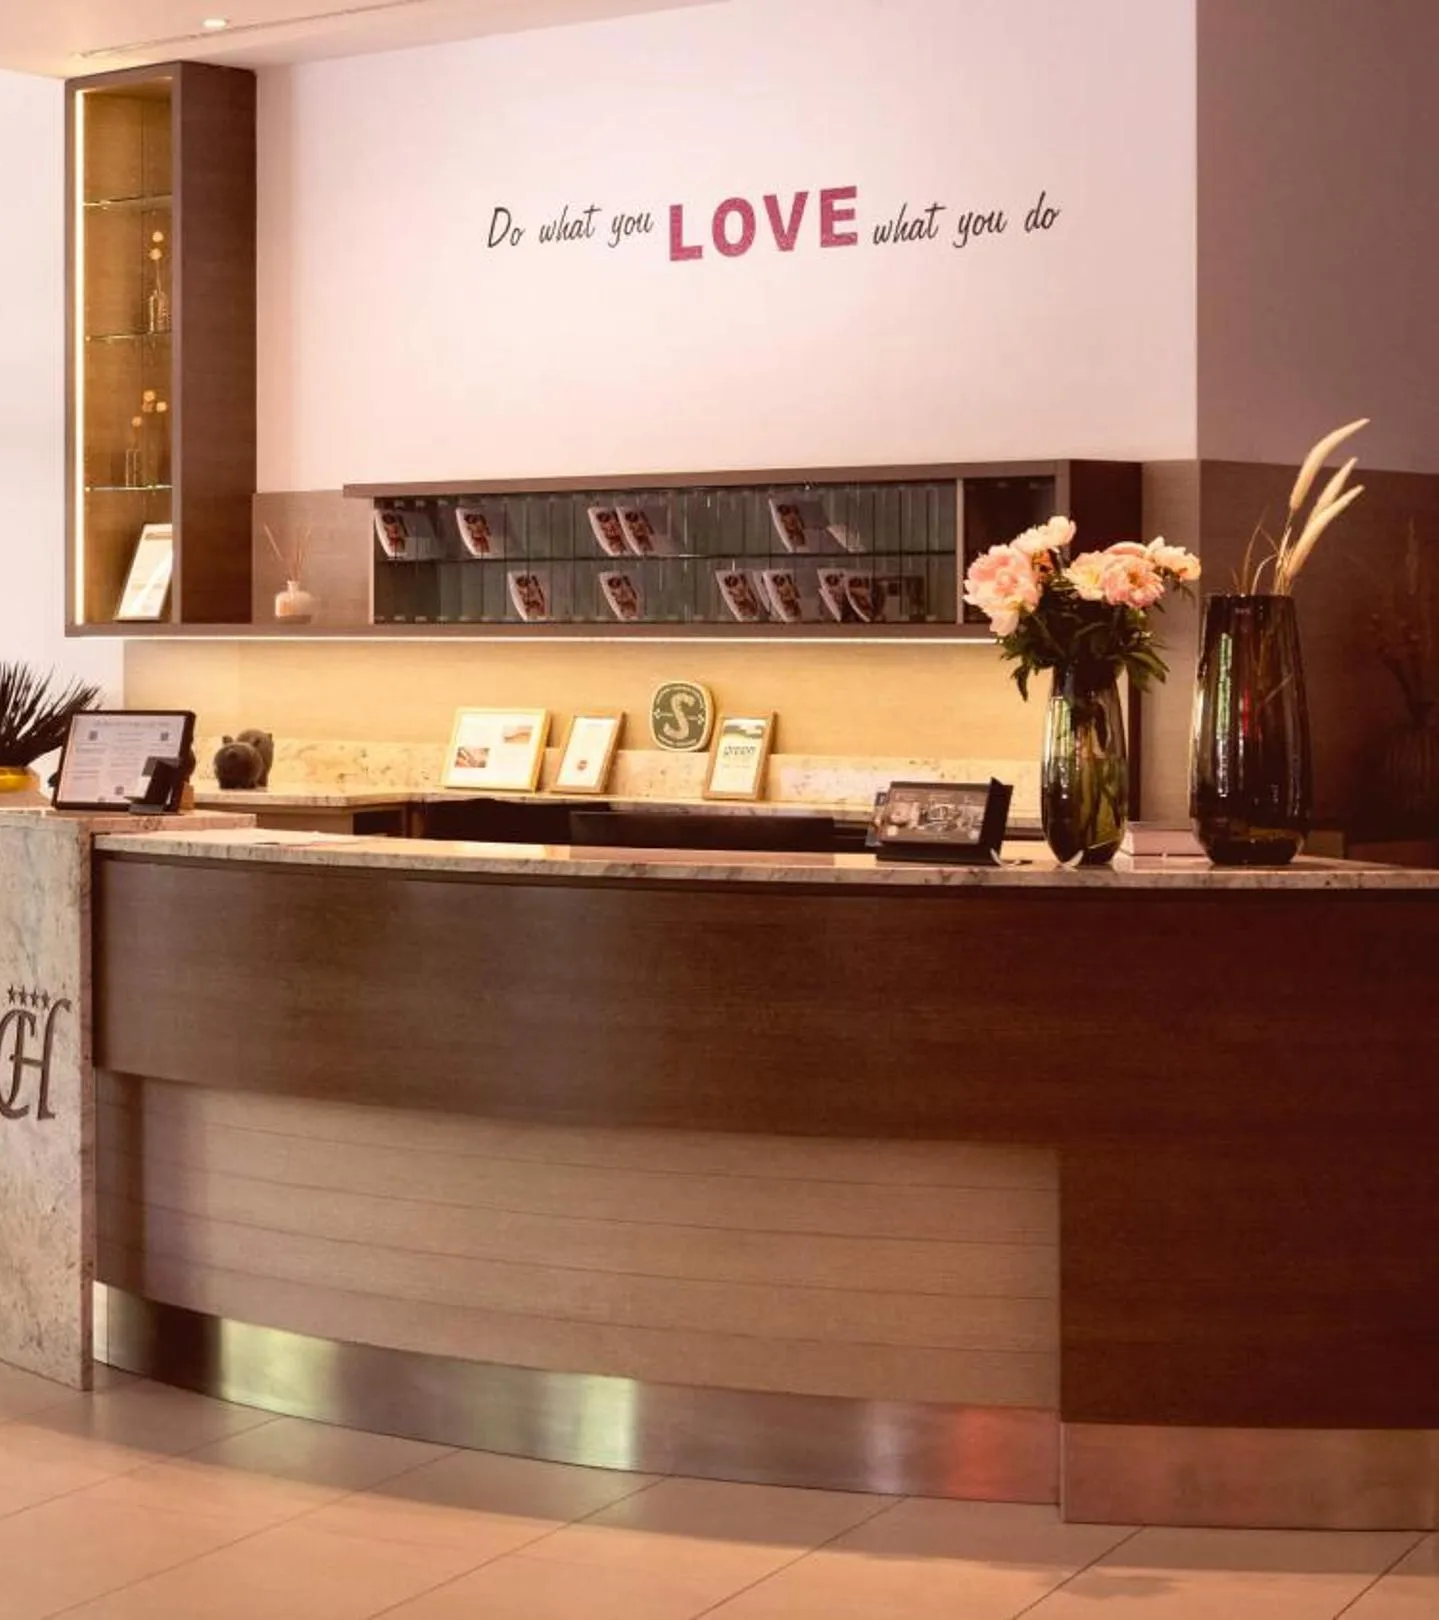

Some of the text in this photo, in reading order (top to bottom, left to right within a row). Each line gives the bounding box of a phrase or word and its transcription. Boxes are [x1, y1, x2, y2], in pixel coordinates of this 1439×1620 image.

[486, 184, 1062, 263] Do what you LOVE what you do
